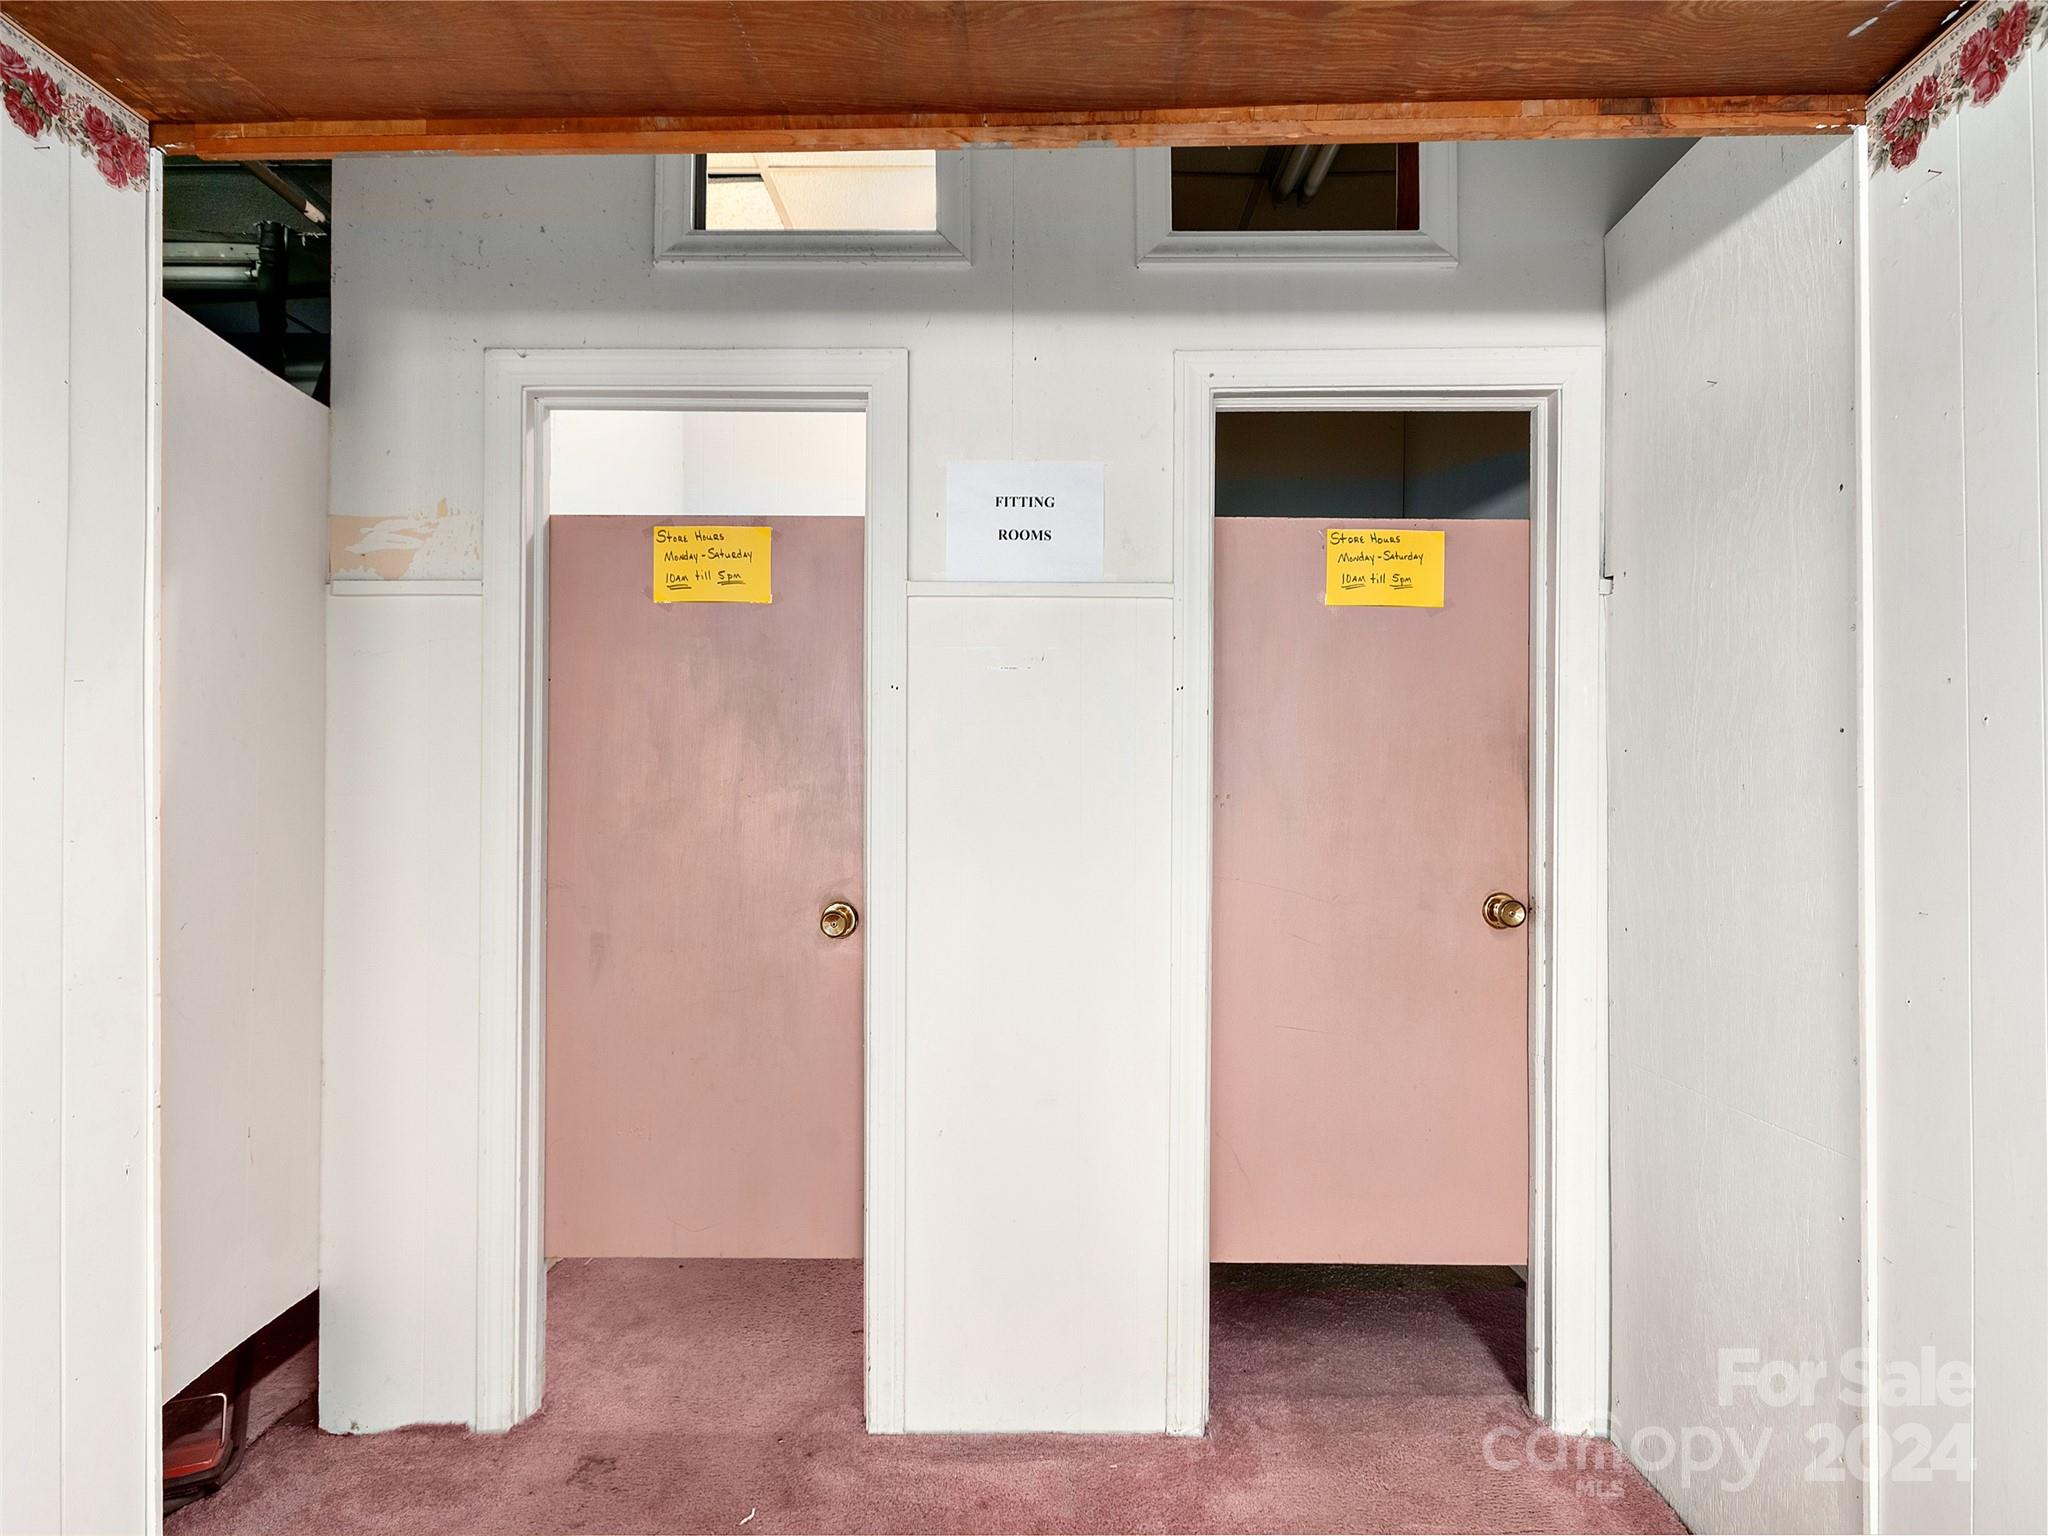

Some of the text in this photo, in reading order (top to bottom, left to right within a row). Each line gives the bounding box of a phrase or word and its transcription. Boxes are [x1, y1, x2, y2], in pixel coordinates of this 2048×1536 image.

[995, 496, 1055, 508] FITTING
[998, 529, 1052, 541] ROOMS
[695, 569, 712, 581] till
[1370, 572, 1386, 584] till
